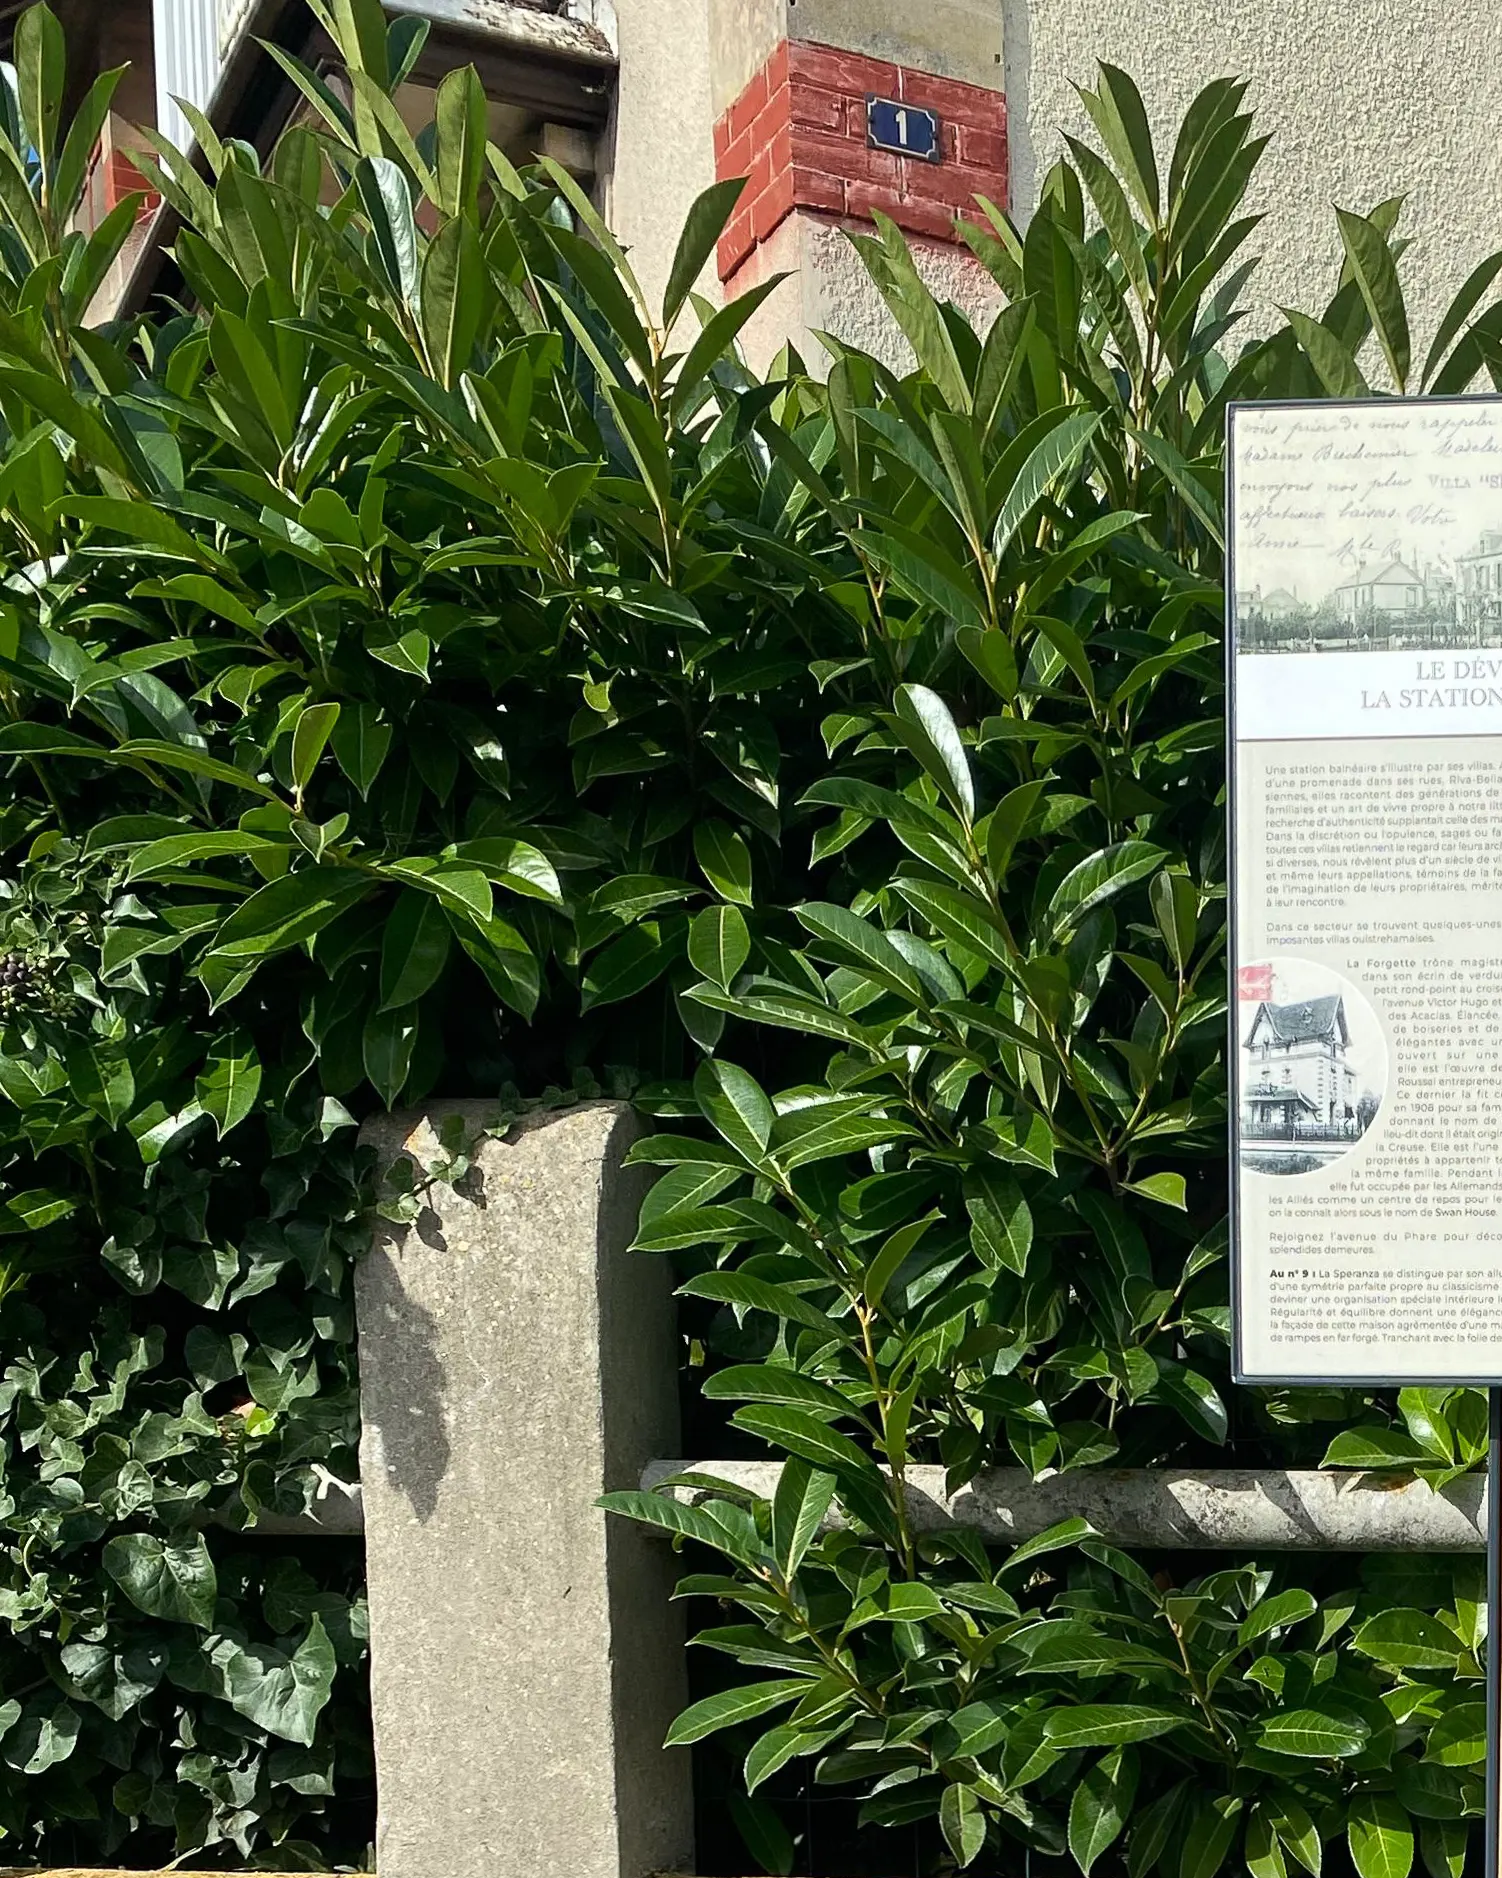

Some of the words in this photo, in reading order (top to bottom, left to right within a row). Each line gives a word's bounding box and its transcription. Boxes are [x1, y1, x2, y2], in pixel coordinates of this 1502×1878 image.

[896, 110, 908, 145] 1
[1416, 661, 1445, 681] LE
[1361, 690, 1396, 709] LA
[1366, 957, 1416, 970] Forgette
[1434, 1207, 1462, 1216] Swan
[1464, 1207, 1497, 1216] House.
[1269, 1268, 1285, 1277] Au
[1287, 1268, 1299, 1277] n°
[1301, 1268, 1309, 1277] 9
